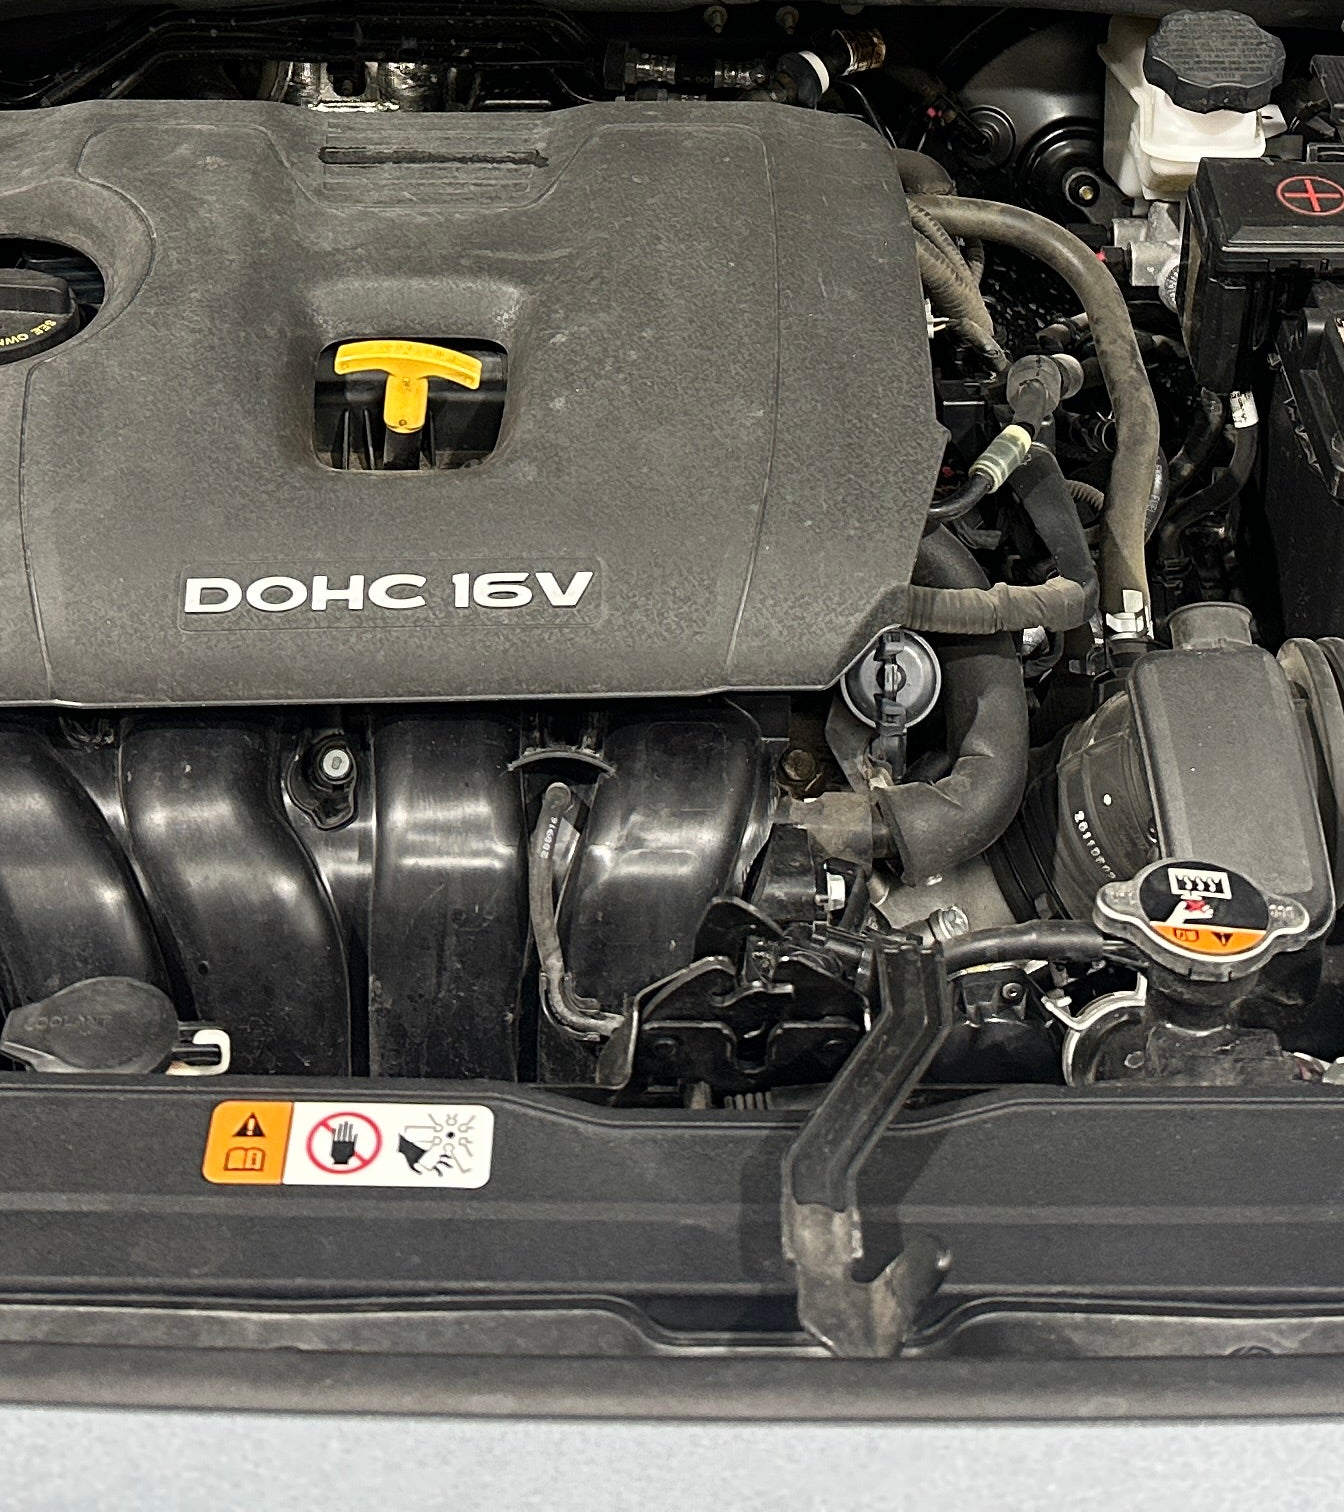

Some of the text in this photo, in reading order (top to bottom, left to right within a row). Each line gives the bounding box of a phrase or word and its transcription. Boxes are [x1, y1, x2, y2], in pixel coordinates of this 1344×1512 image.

[31, 319, 57, 336] SEE
[183, 570, 595, 616] DOHC 16V
[24, 1014, 113, 1031] COOLANT
